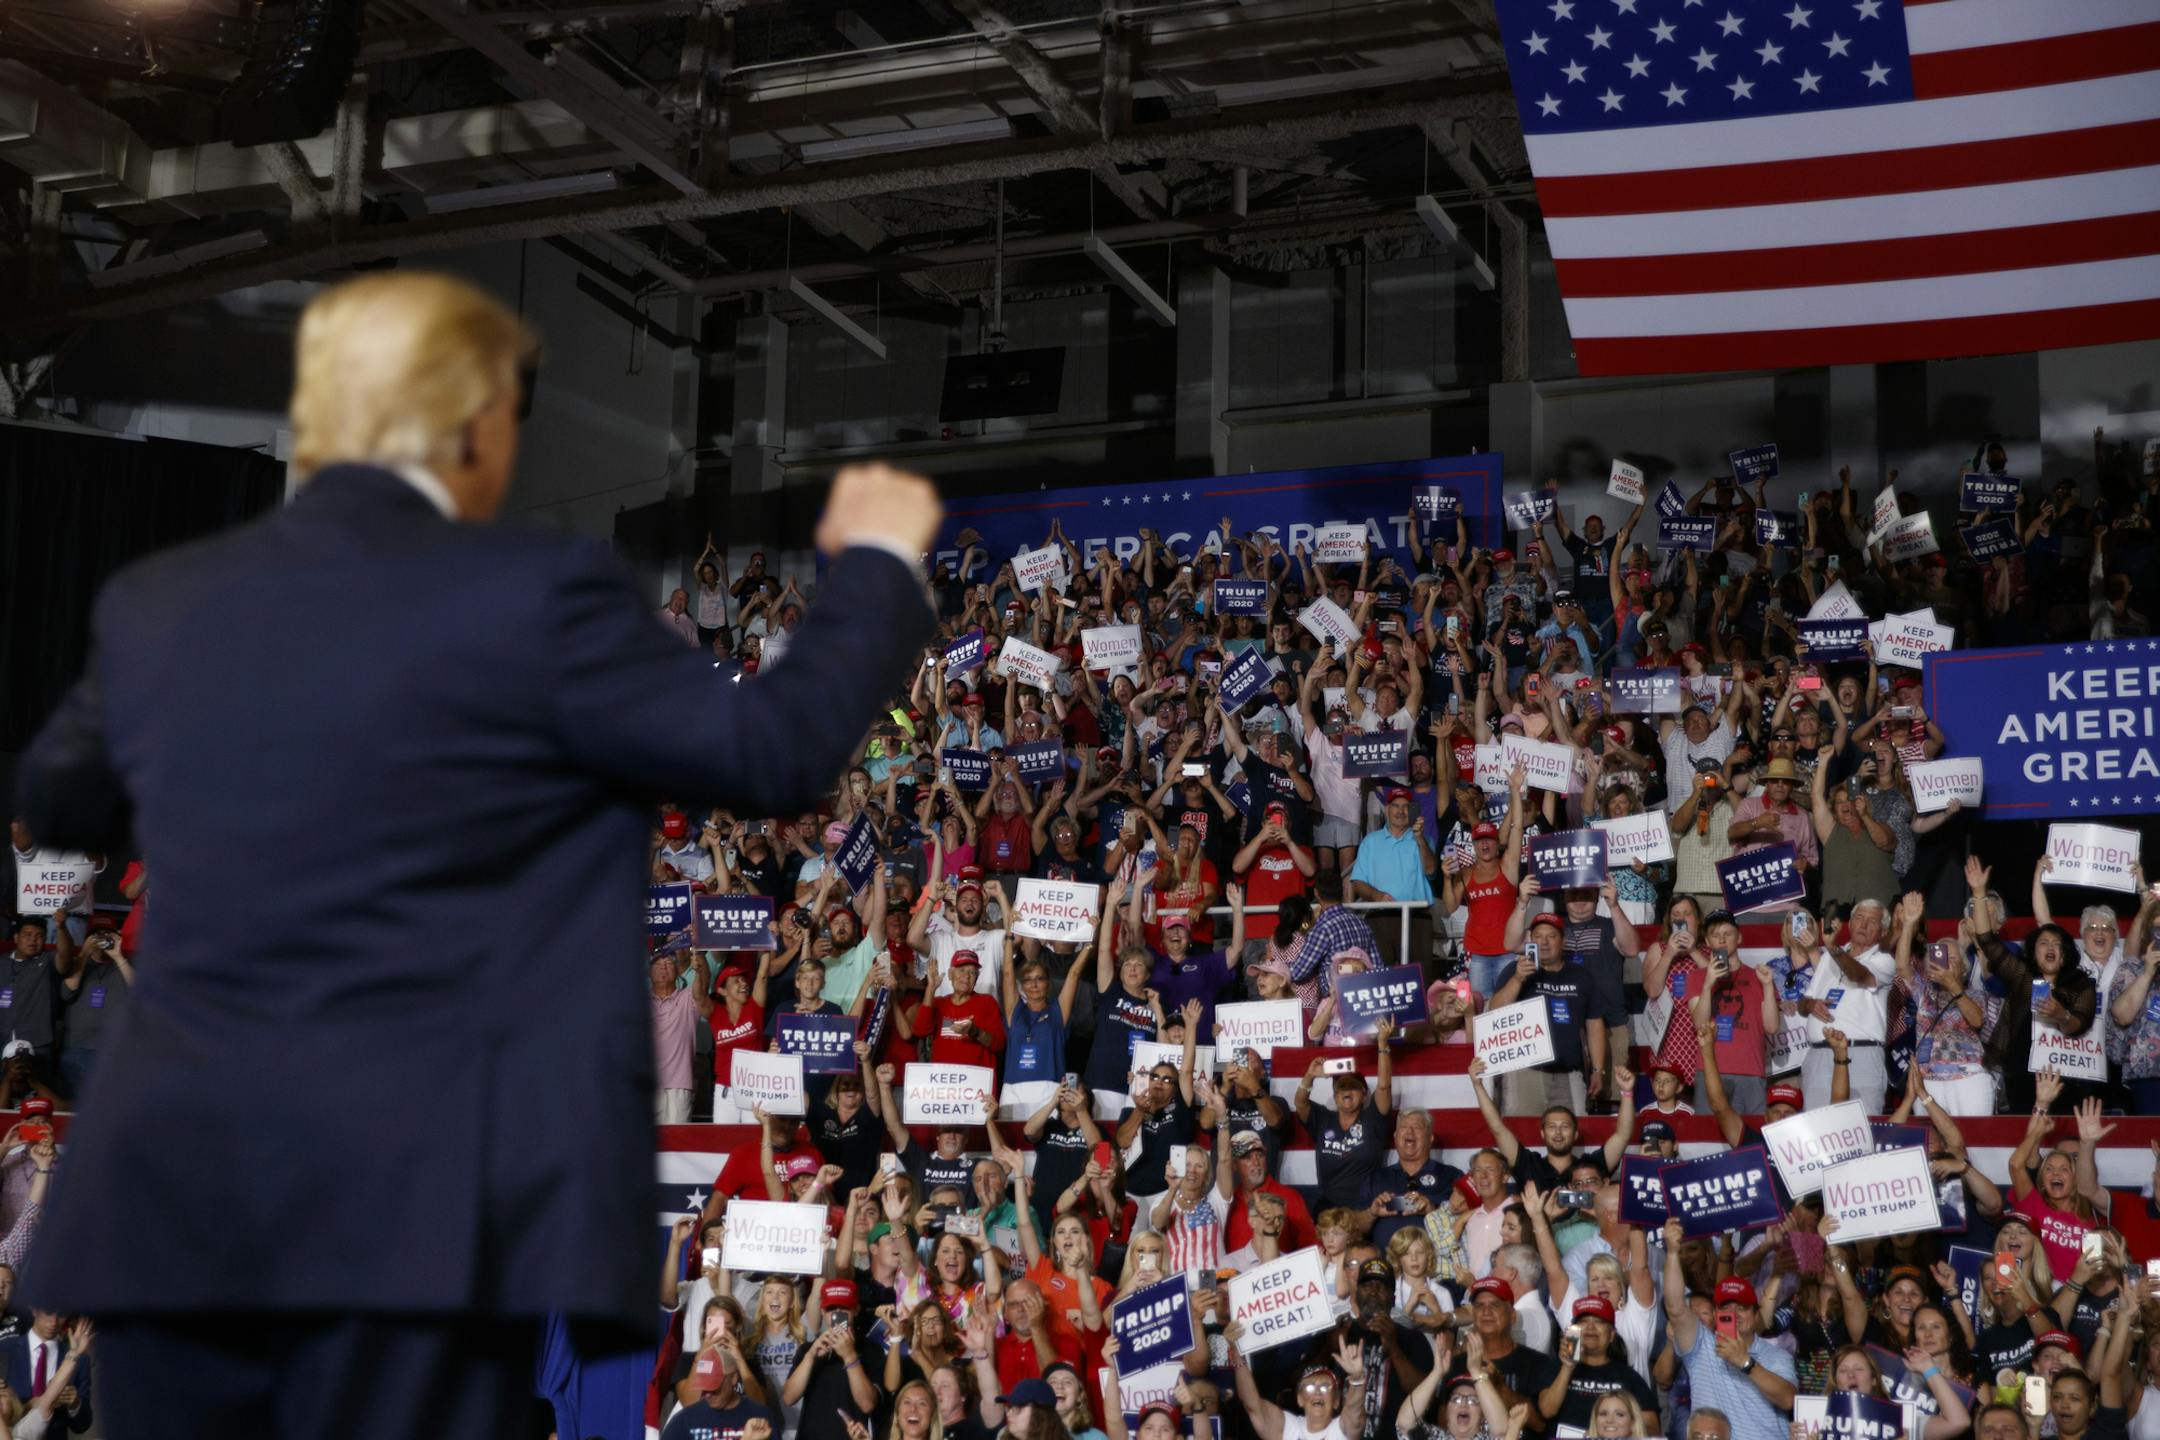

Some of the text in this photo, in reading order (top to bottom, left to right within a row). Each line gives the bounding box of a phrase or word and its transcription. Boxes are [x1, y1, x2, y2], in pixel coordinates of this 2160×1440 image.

[1735, 452, 1776, 467] TRUMP
[1612, 473, 1644, 489] AMERIC
[1966, 482, 2019, 493] TRUMP
[1977, 495, 2004, 504] 2020
[1662, 523, 1713, 532] TRUMP
[1256, 516, 1432, 558] GRAT!
[1329, 532, 1351, 540] KEEP
[1671, 534, 1699, 542] 2020
[1319, 540, 1363, 549] AMERICA
[1324, 550, 1355, 558] GREAT!
[936, 549, 989, 580] EP
[1019, 559, 1061, 579] AMERICA
[1217, 587, 1265, 596] TRUMP
[1803, 629, 1863, 640] TRUMP
[1903, 625, 1934, 639] KEEP
[1087, 637, 1136, 653] Women
[1885, 634, 1946, 653] AMERICA
[1018, 648, 1043, 662] KEEP
[1111, 649, 1134, 657] TRUMP
[1003, 653, 1050, 677] AMERICA
[1222, 655, 1257, 689] RUMP
[1231, 675, 1255, 698] 2020
[1617, 679, 1674, 689] TRUMP
[1348, 743, 1403, 754] TRUMP
[944, 757, 990, 769] TRUMP
[1013, 751, 1059, 763] RUMP
[1022, 759, 1055, 769] ENCE
[1352, 752, 1398, 761] PENCE
[1506, 746, 1565, 771] Women
[955, 773, 981, 781] 2020
[1917, 774, 1978, 791] Women
[840, 822, 871, 871] TRUMP
[1533, 846, 1600, 861] TRUMP
[1610, 842, 1659, 855] FOR TRUMP
[2054, 838, 2132, 866] Women
[856, 844, 876, 873] 2020
[1539, 857, 1594, 868] PENCE
[2059, 859, 2081, 868] FOR
[41, 871, 75, 881] KEEP
[1725, 858, 1792, 885] TRUMP
[1734, 870, 1789, 891] PENCE
[1038, 889, 1074, 902] KEEP
[1469, 887, 1500, 899] MAGA
[33, 898, 72, 908] GREA
[1019, 902, 1089, 919] AMERICA
[702, 910, 769, 921] TRUMP
[708, 921, 763, 929] PENCE
[1029, 918, 1078, 931] GREAT!
[1344, 981, 1417, 1001] TRUMP
[1353, 995, 1413, 1011] PENCE
[1223, 1018, 1295, 1038] Women
[1492, 1014, 1523, 1031] KEEP
[717, 1022, 752, 1040] TRUMP
[782, 1030, 852, 1042] TRUMP
[1479, 1024, 1544, 1051] AMERICA
[787, 1042, 845, 1051] PENCE
[1231, 1035, 1288, 1045] FOR TRUMP
[2038, 1033, 2103, 1055] AMERICA
[1489, 1044, 1538, 1065] GREAT!
[2049, 1053, 2096, 1070] GREAT!
[735, 1066, 795, 1090] Women
[930, 1073, 967, 1083] KEEP
[757, 1092, 788, 1100] TRUMP
[910, 1087, 985, 1101] AMERICA
[922, 1103, 974, 1115] GREAT!
[1779, 1125, 1867, 1164] Women
[1829, 1149, 1863, 1165] TRUMP
[925, 1168, 967, 1179] TRUMP
[1671, 1169, 1761, 1201] TRUMP
[1829, 1175, 1923, 1208] Women
[1683, 1187, 1757, 1212] PENCE
[1707, 1205, 1731, 1214] AMERICA
[1841, 1200, 1917, 1220] FOR TRUMP
[734, 1218, 816, 1245] Women
[2040, 1229, 2079, 1248] TRUM
[768, 1245, 807, 1254] TRUMP
[1252, 1269, 1292, 1294] KEEP
[1237, 1281, 1320, 1321] AMERICA
[1115, 1293, 1185, 1332] TRUMP
[1253, 1304, 1313, 1335] GREAT!
[1133, 1327, 1171, 1352] 2020
[758, 1343, 795, 1354] RUMP
[1989, 1339, 2034, 1362] TRUMP
[1571, 1380, 1621, 1390] RUMP
[1881, 1374, 1936, 1413] RUM
[1819, 1415, 1896, 1439] RUMP
